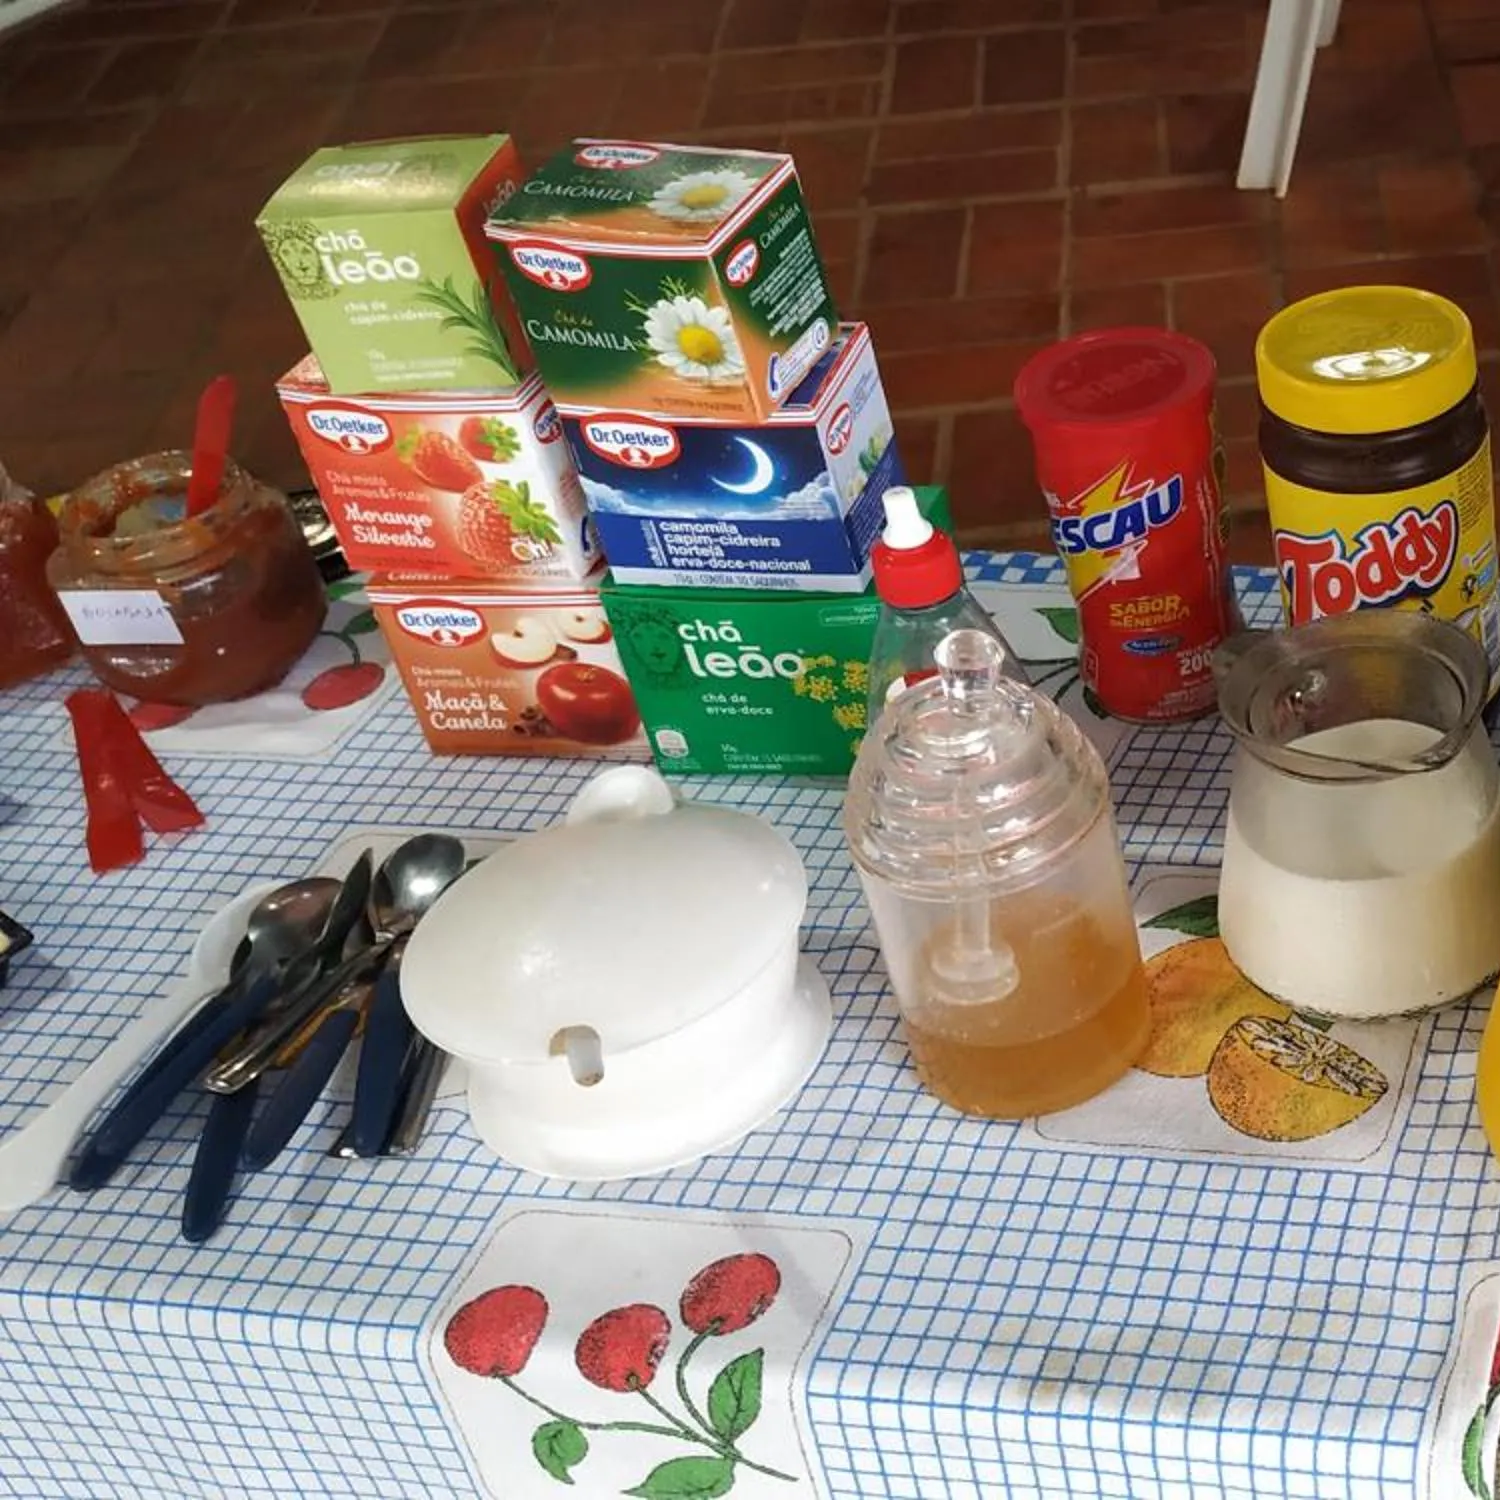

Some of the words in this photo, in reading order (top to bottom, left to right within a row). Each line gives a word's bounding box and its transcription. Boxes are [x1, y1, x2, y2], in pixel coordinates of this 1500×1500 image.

[524, 181, 633, 202] CAMOMILA
[321, 251, 420, 286] leão
[527, 319, 637, 352] CAMOMILA
[343, 502, 433, 535] Morango
[659, 521, 739, 535] camomila
[352, 524, 436, 549] Silvestre
[663, 532, 782, 548] capim-cidreira
[671, 557, 811, 571] erva-doce-nacional
[1276, 502, 1456, 627] Toddy
[1109, 593, 1183, 618] SABOR
[683, 643, 806, 679] leão
[424, 688, 486, 715] Maçã
[489, 693, 508, 712] &
[430, 711, 507, 731] Canela
